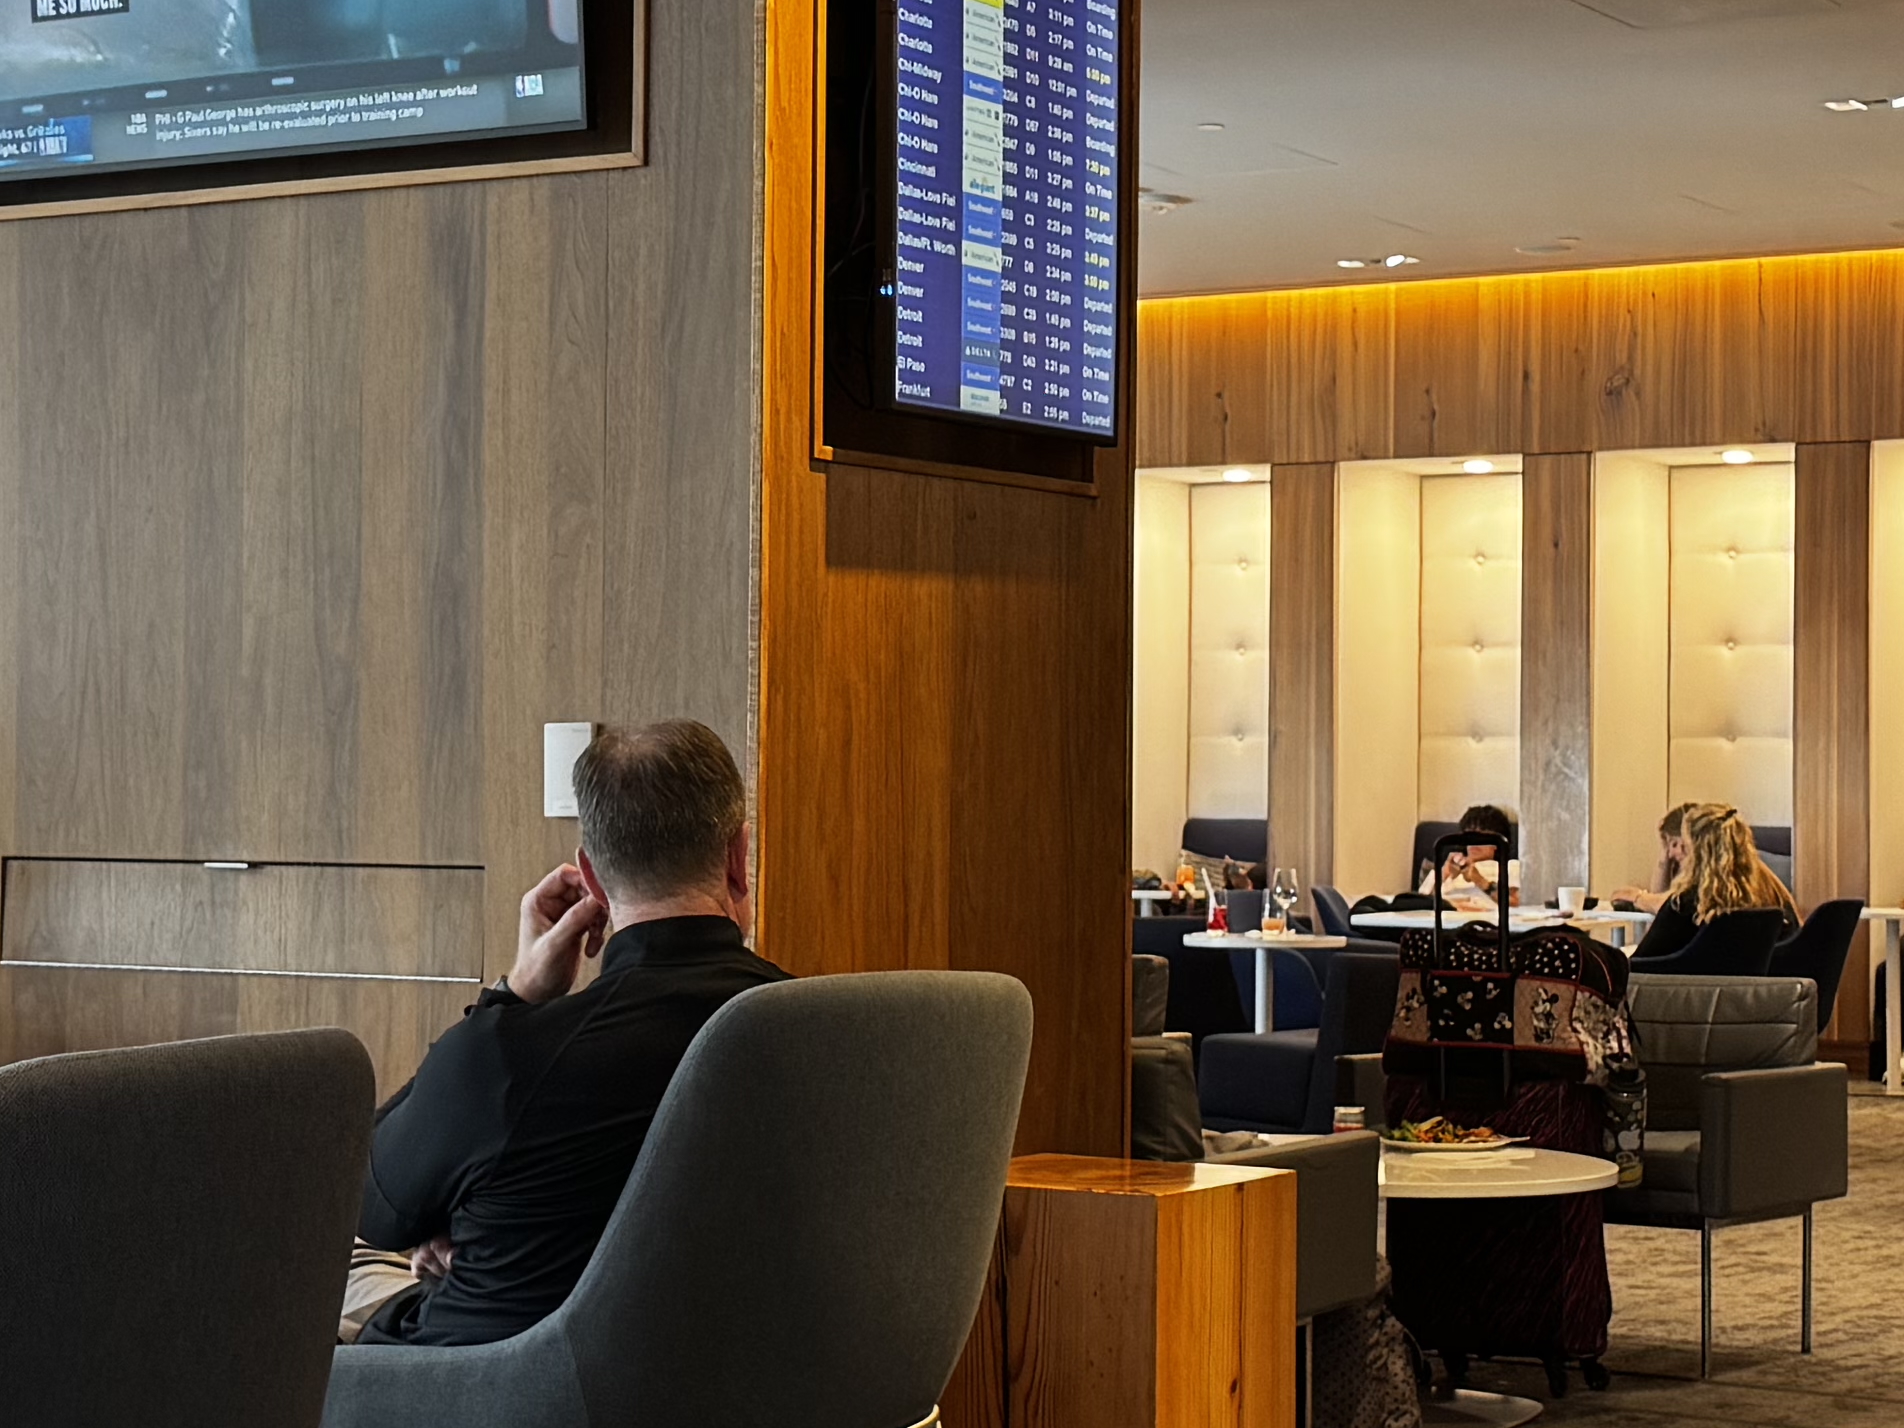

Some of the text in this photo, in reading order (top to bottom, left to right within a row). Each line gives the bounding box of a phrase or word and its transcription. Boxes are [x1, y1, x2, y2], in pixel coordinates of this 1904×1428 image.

[1086, 20, 1096, 34] On
[1097, 23, 1113, 40] Time
[1086, 43, 1096, 57] On
[1096, 46, 1113, 62] Time
[1085, 181, 1095, 195] On
[1096, 184, 1112, 199] Time
[1082, 365, 1092, 378] On
[1093, 367, 1109, 381] Time
[1081, 388, 1092, 401] On
[1093, 390, 1109, 404] Time
